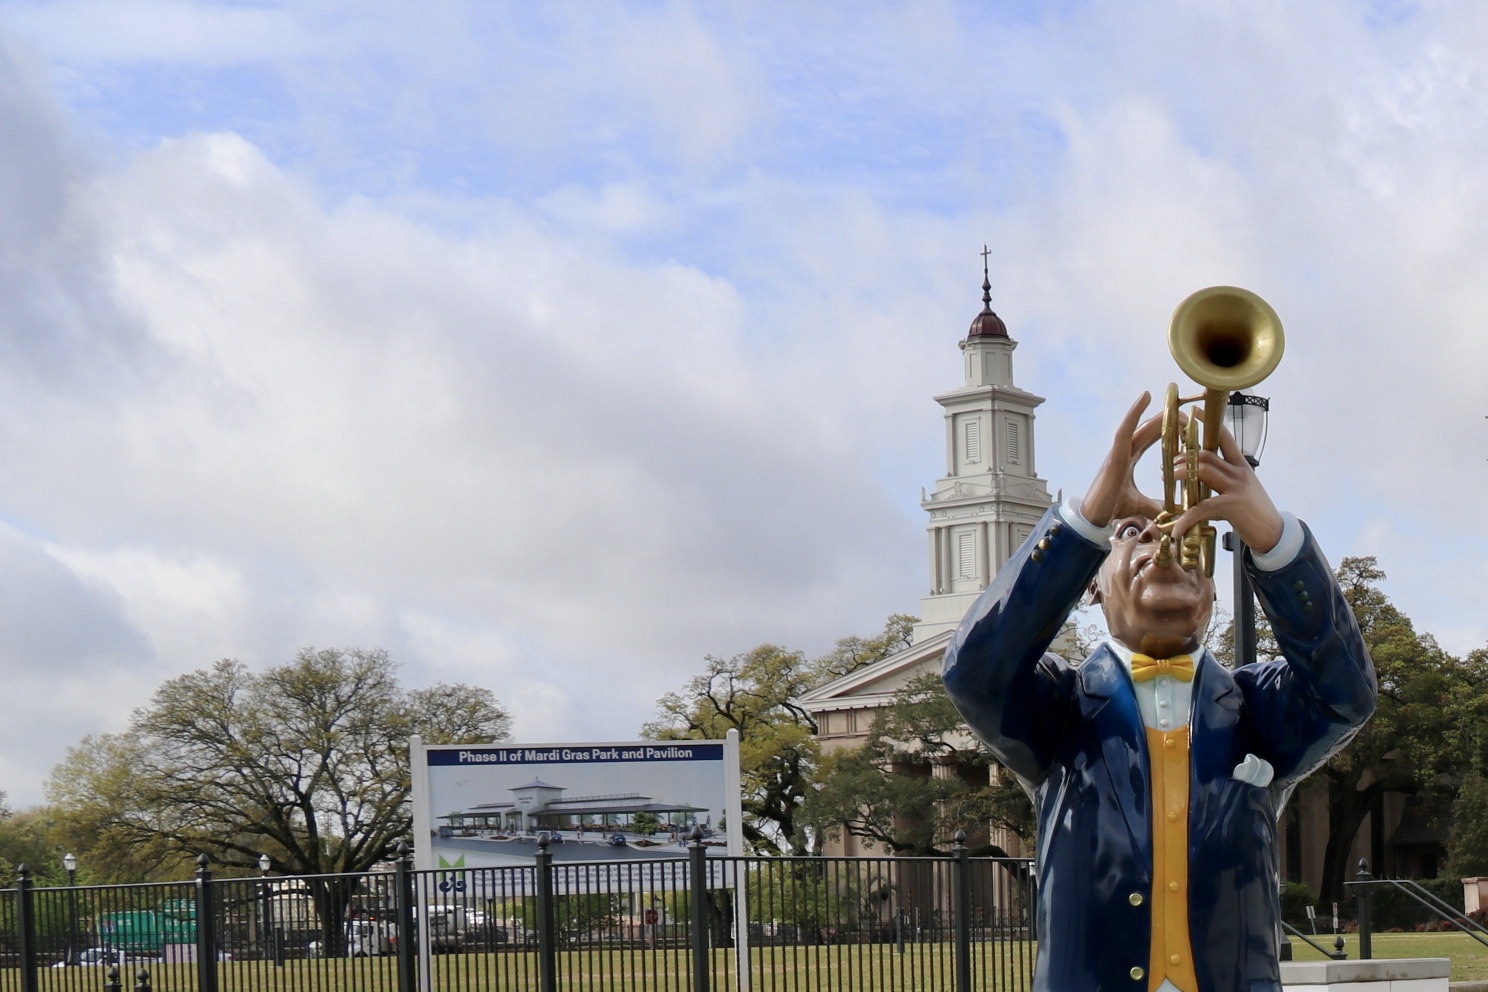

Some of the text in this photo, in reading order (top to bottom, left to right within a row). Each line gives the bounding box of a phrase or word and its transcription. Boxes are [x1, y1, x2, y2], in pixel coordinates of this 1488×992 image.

[459, 747, 693, 763] Phase II of Mardi Gras Park and Pavilion
